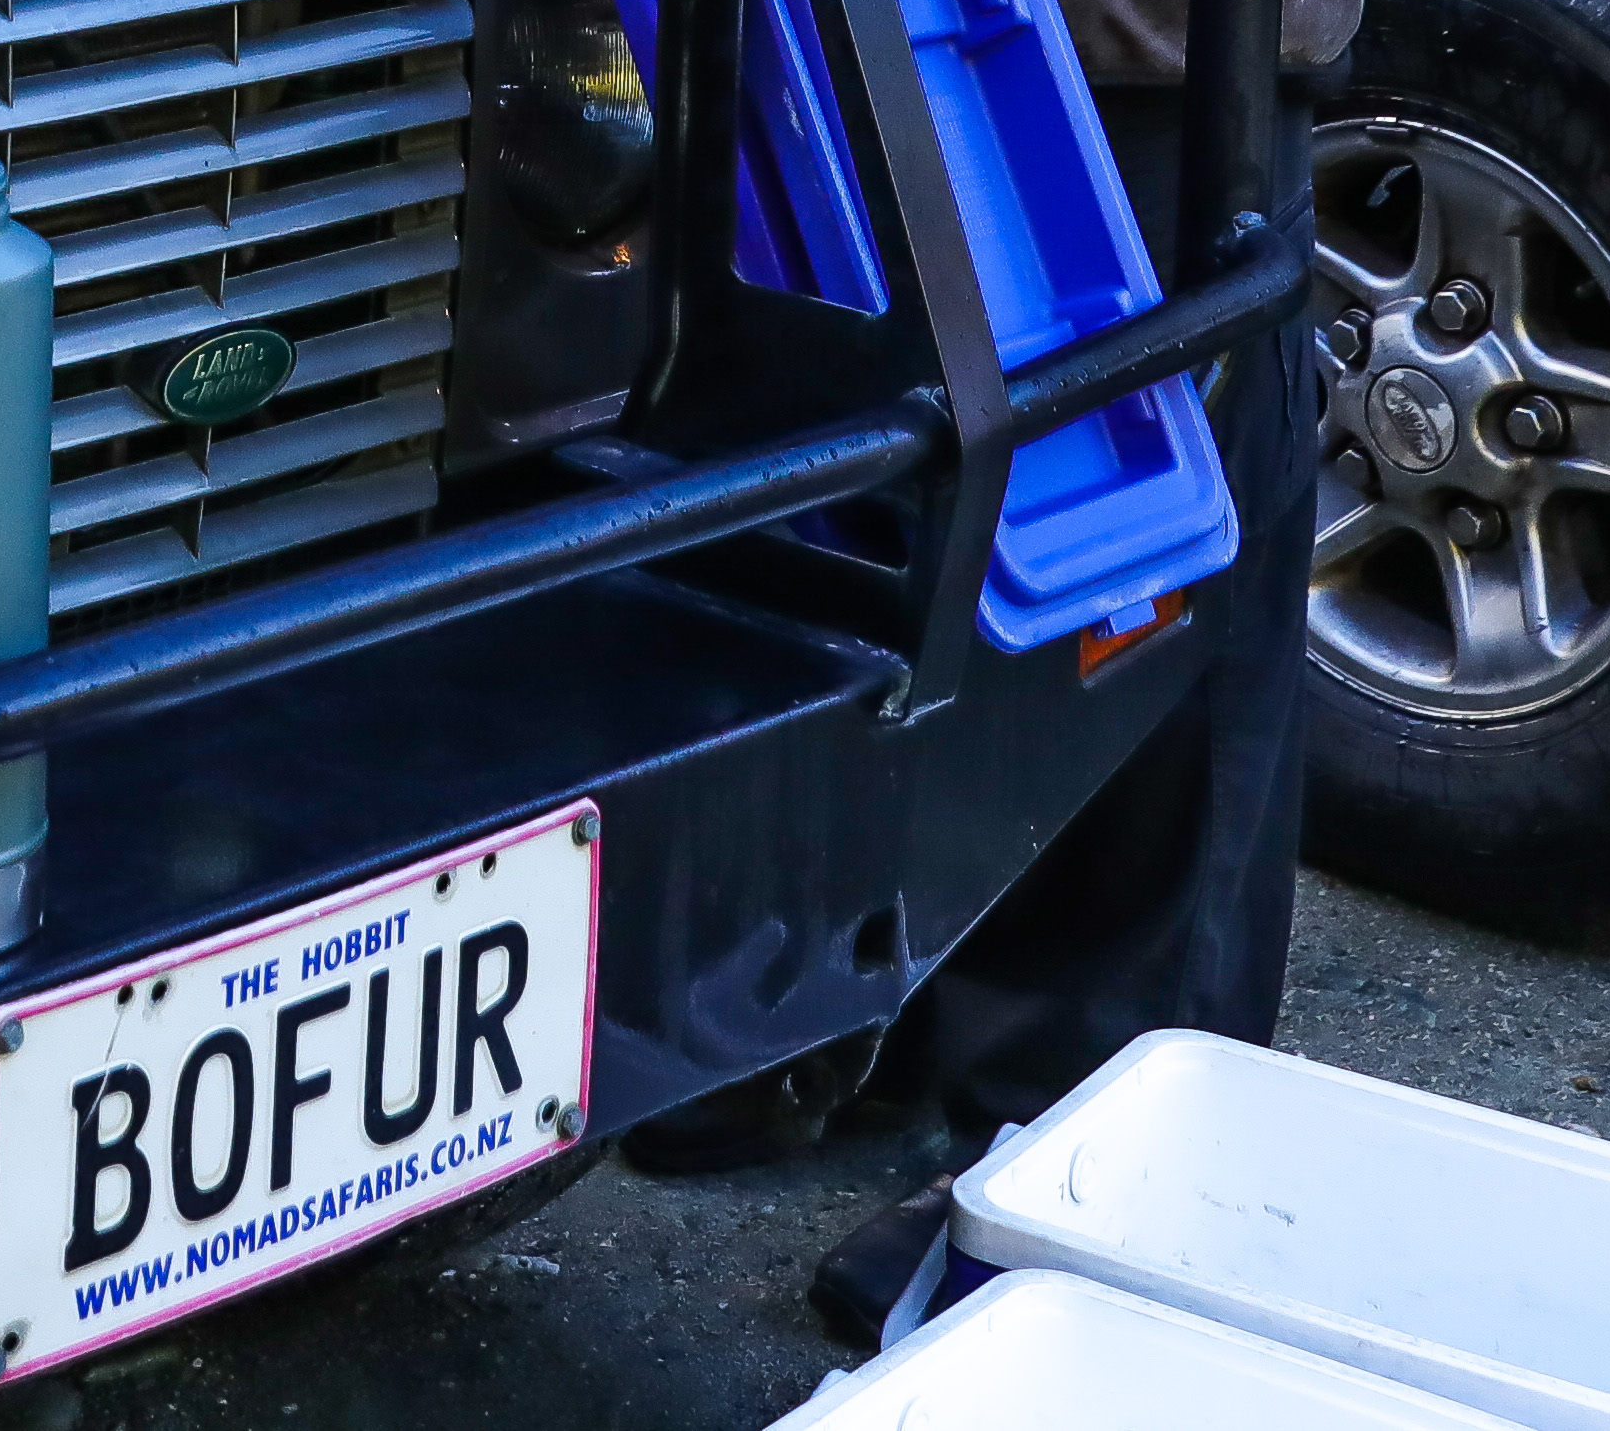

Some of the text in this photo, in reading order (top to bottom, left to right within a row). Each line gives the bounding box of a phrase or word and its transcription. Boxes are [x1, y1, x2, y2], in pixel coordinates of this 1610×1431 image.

[221, 908, 411, 1009] THE HOBBIT
[63, 919, 530, 1274] BOFUR
[74, 1110, 514, 1322] WWW.NOMADSAFARIS.CO.NZ
